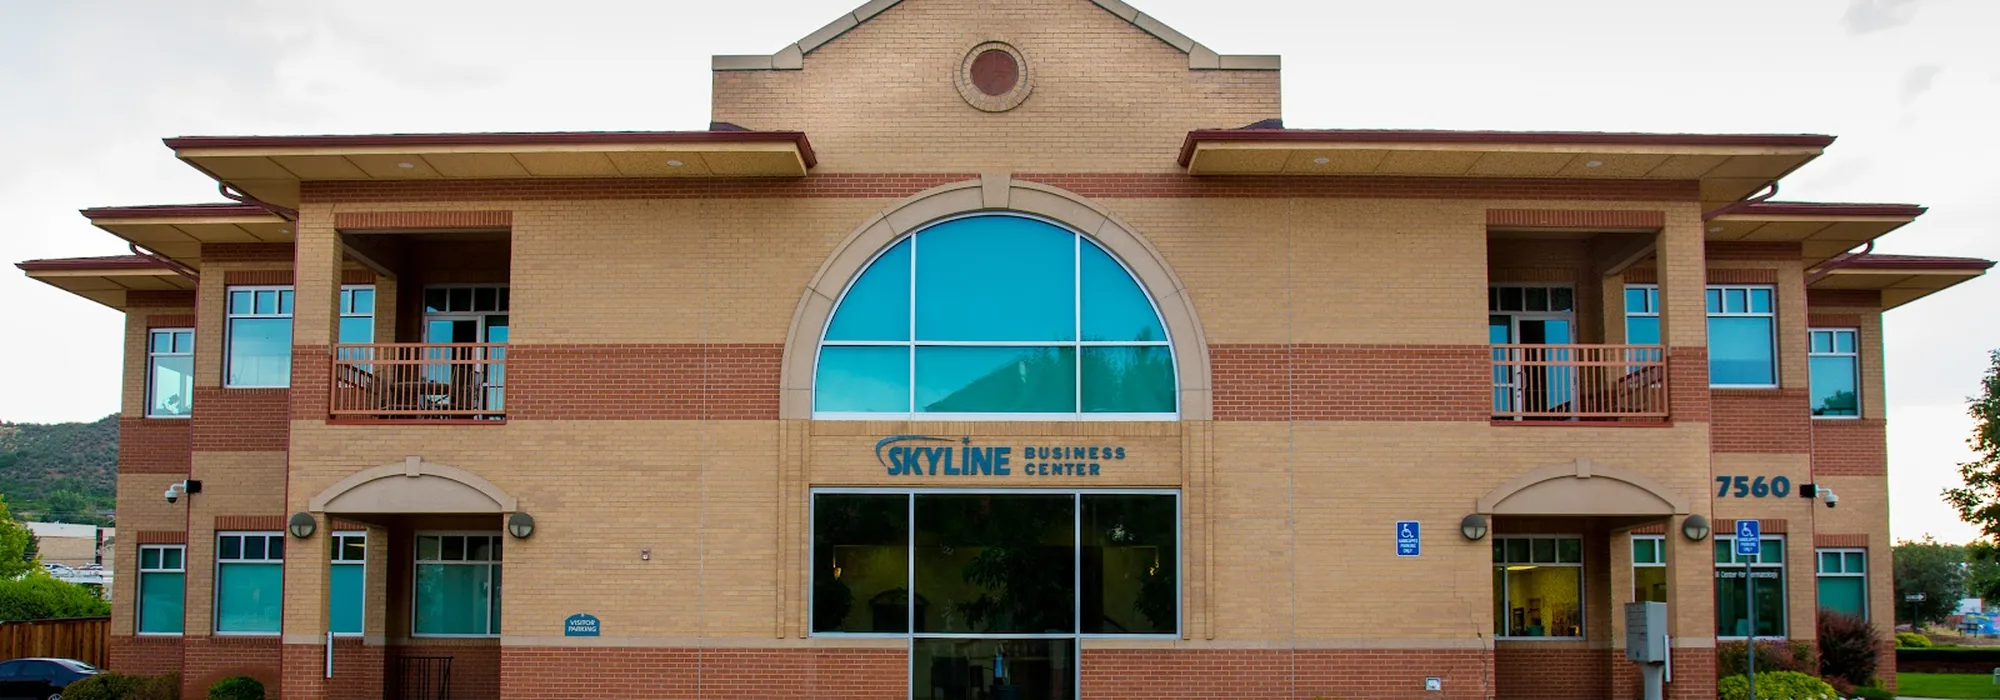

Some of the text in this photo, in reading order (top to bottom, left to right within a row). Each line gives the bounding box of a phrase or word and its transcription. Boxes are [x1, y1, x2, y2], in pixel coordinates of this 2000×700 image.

[1024, 446, 1126, 460] BUSINESS
[887, 446, 1011, 476] SKYLINE
[1024, 463, 1101, 476] CENTER
[1716, 475, 1791, 498] 7560
[1748, 571, 1779, 579] ermatology
